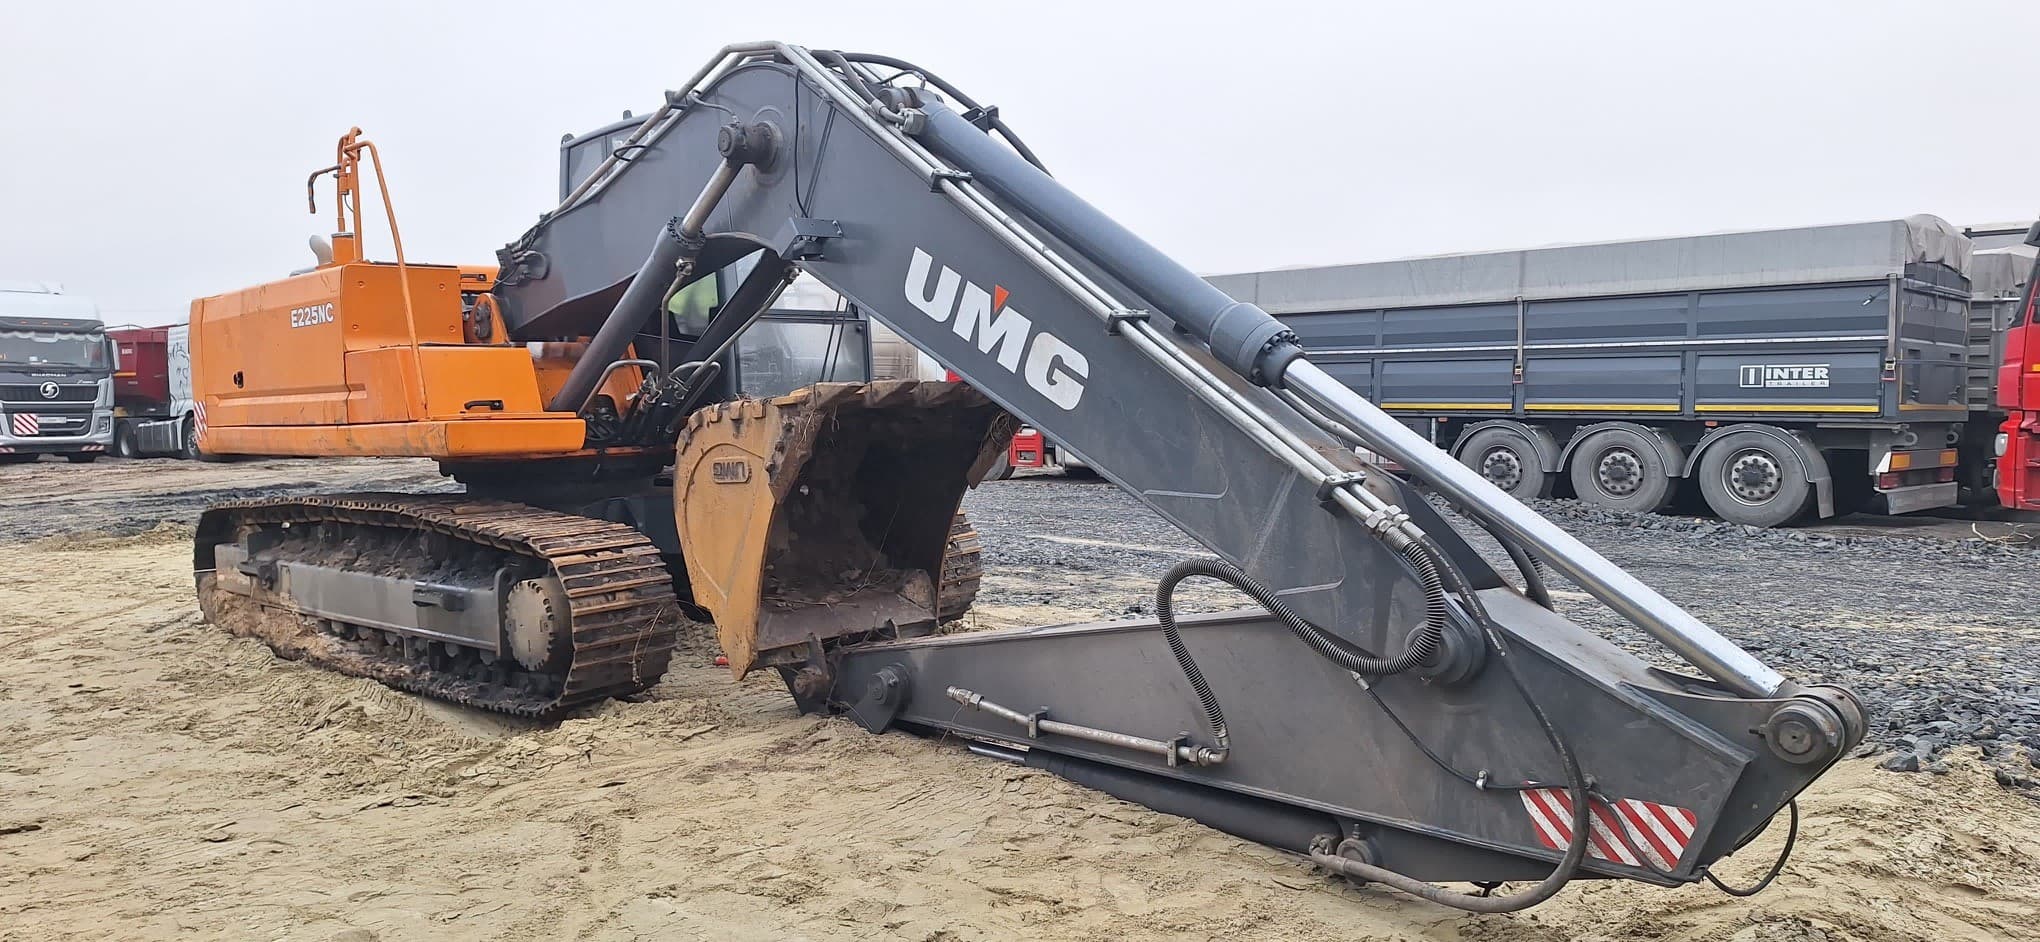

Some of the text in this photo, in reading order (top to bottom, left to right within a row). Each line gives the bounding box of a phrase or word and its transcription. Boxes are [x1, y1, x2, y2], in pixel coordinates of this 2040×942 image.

[291, 303, 334, 328] E225NC
[905, 246, 1090, 411] UMG
[1766, 368, 1829, 379] INTER
